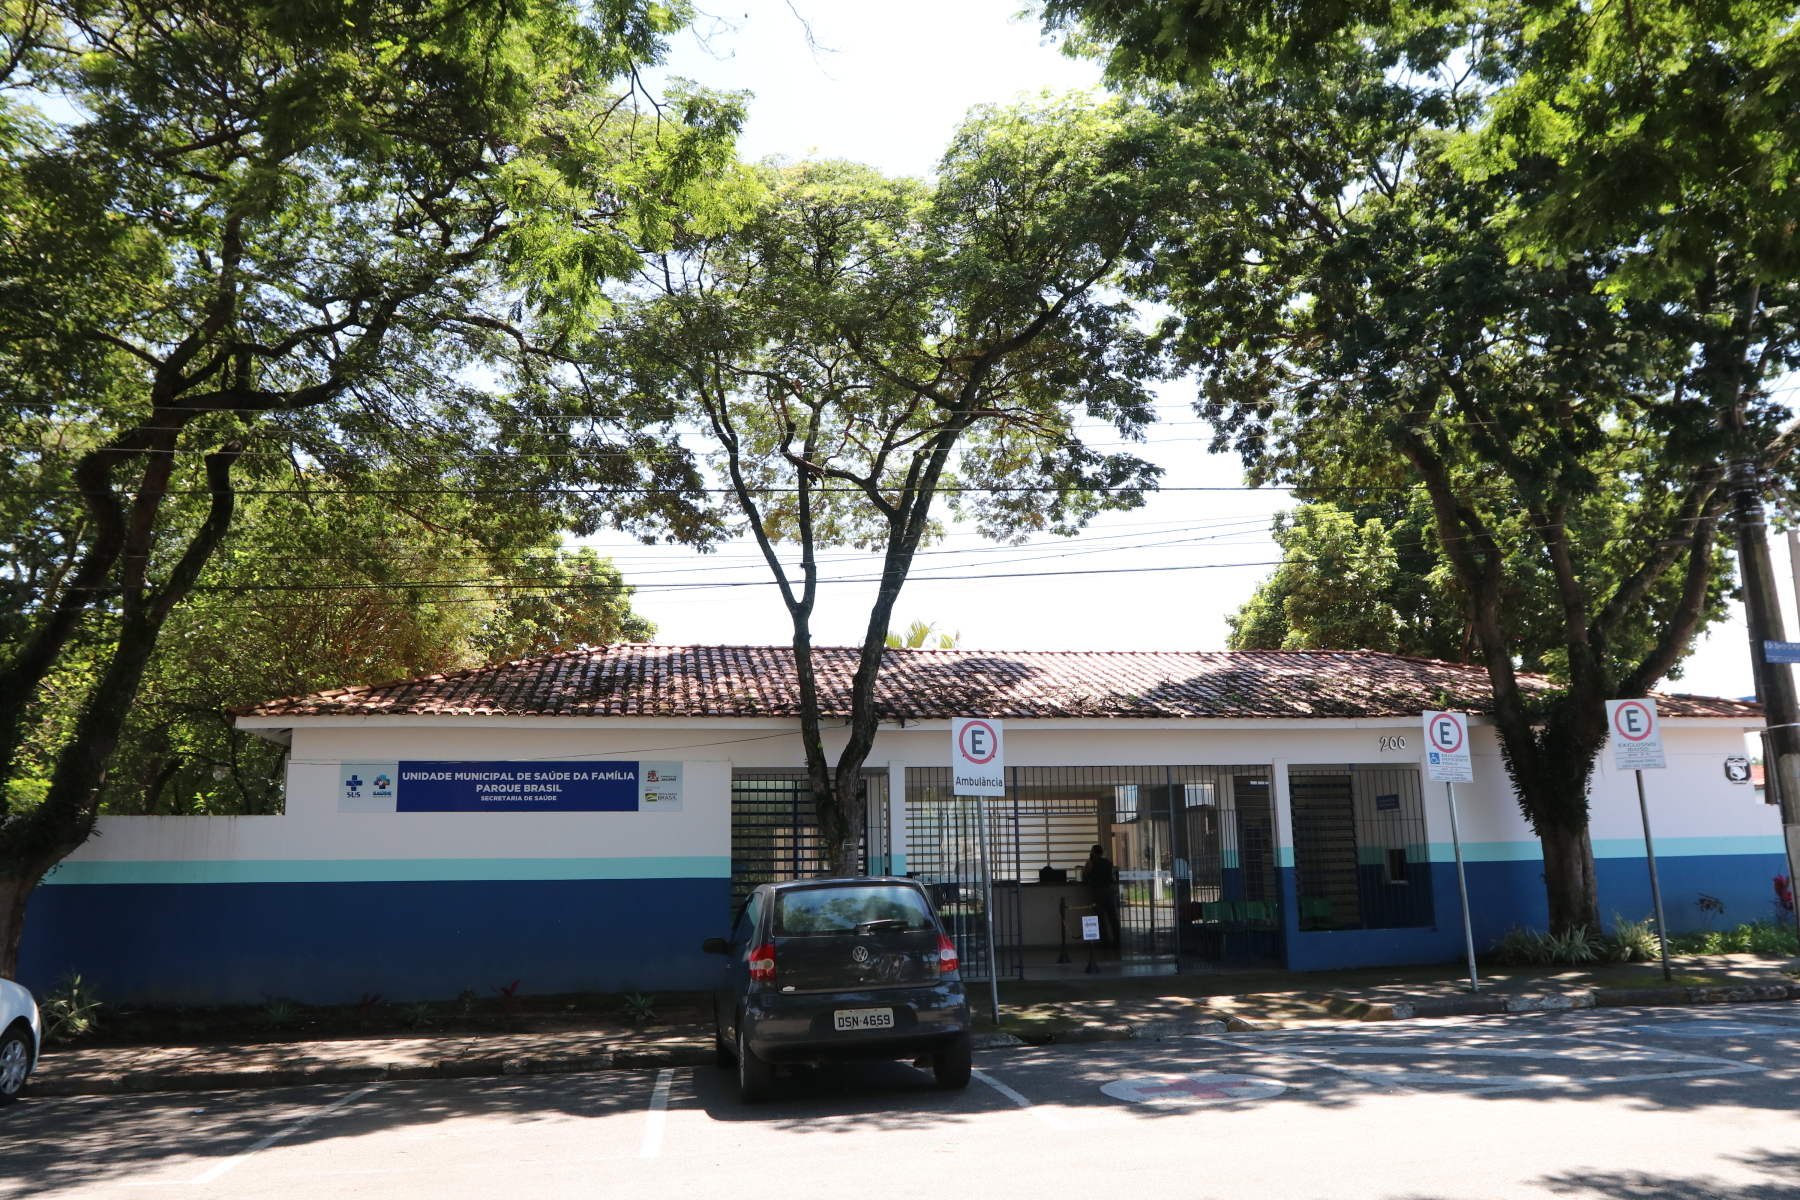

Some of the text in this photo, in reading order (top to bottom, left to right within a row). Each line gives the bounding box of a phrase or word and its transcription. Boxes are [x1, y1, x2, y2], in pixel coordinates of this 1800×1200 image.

[1626, 710, 1641, 732] E
[1440, 722, 1452, 744] E
[972, 730, 985, 754] E
[1379, 736, 1406, 752] 200
[402, 770, 635, 781] UNIDADE MUNICIPAL DE SAÚDE DA FAMÍLIA
[955, 776, 1003, 787] Ambulância
[476, 784, 562, 793] PARQUE BRASIL
